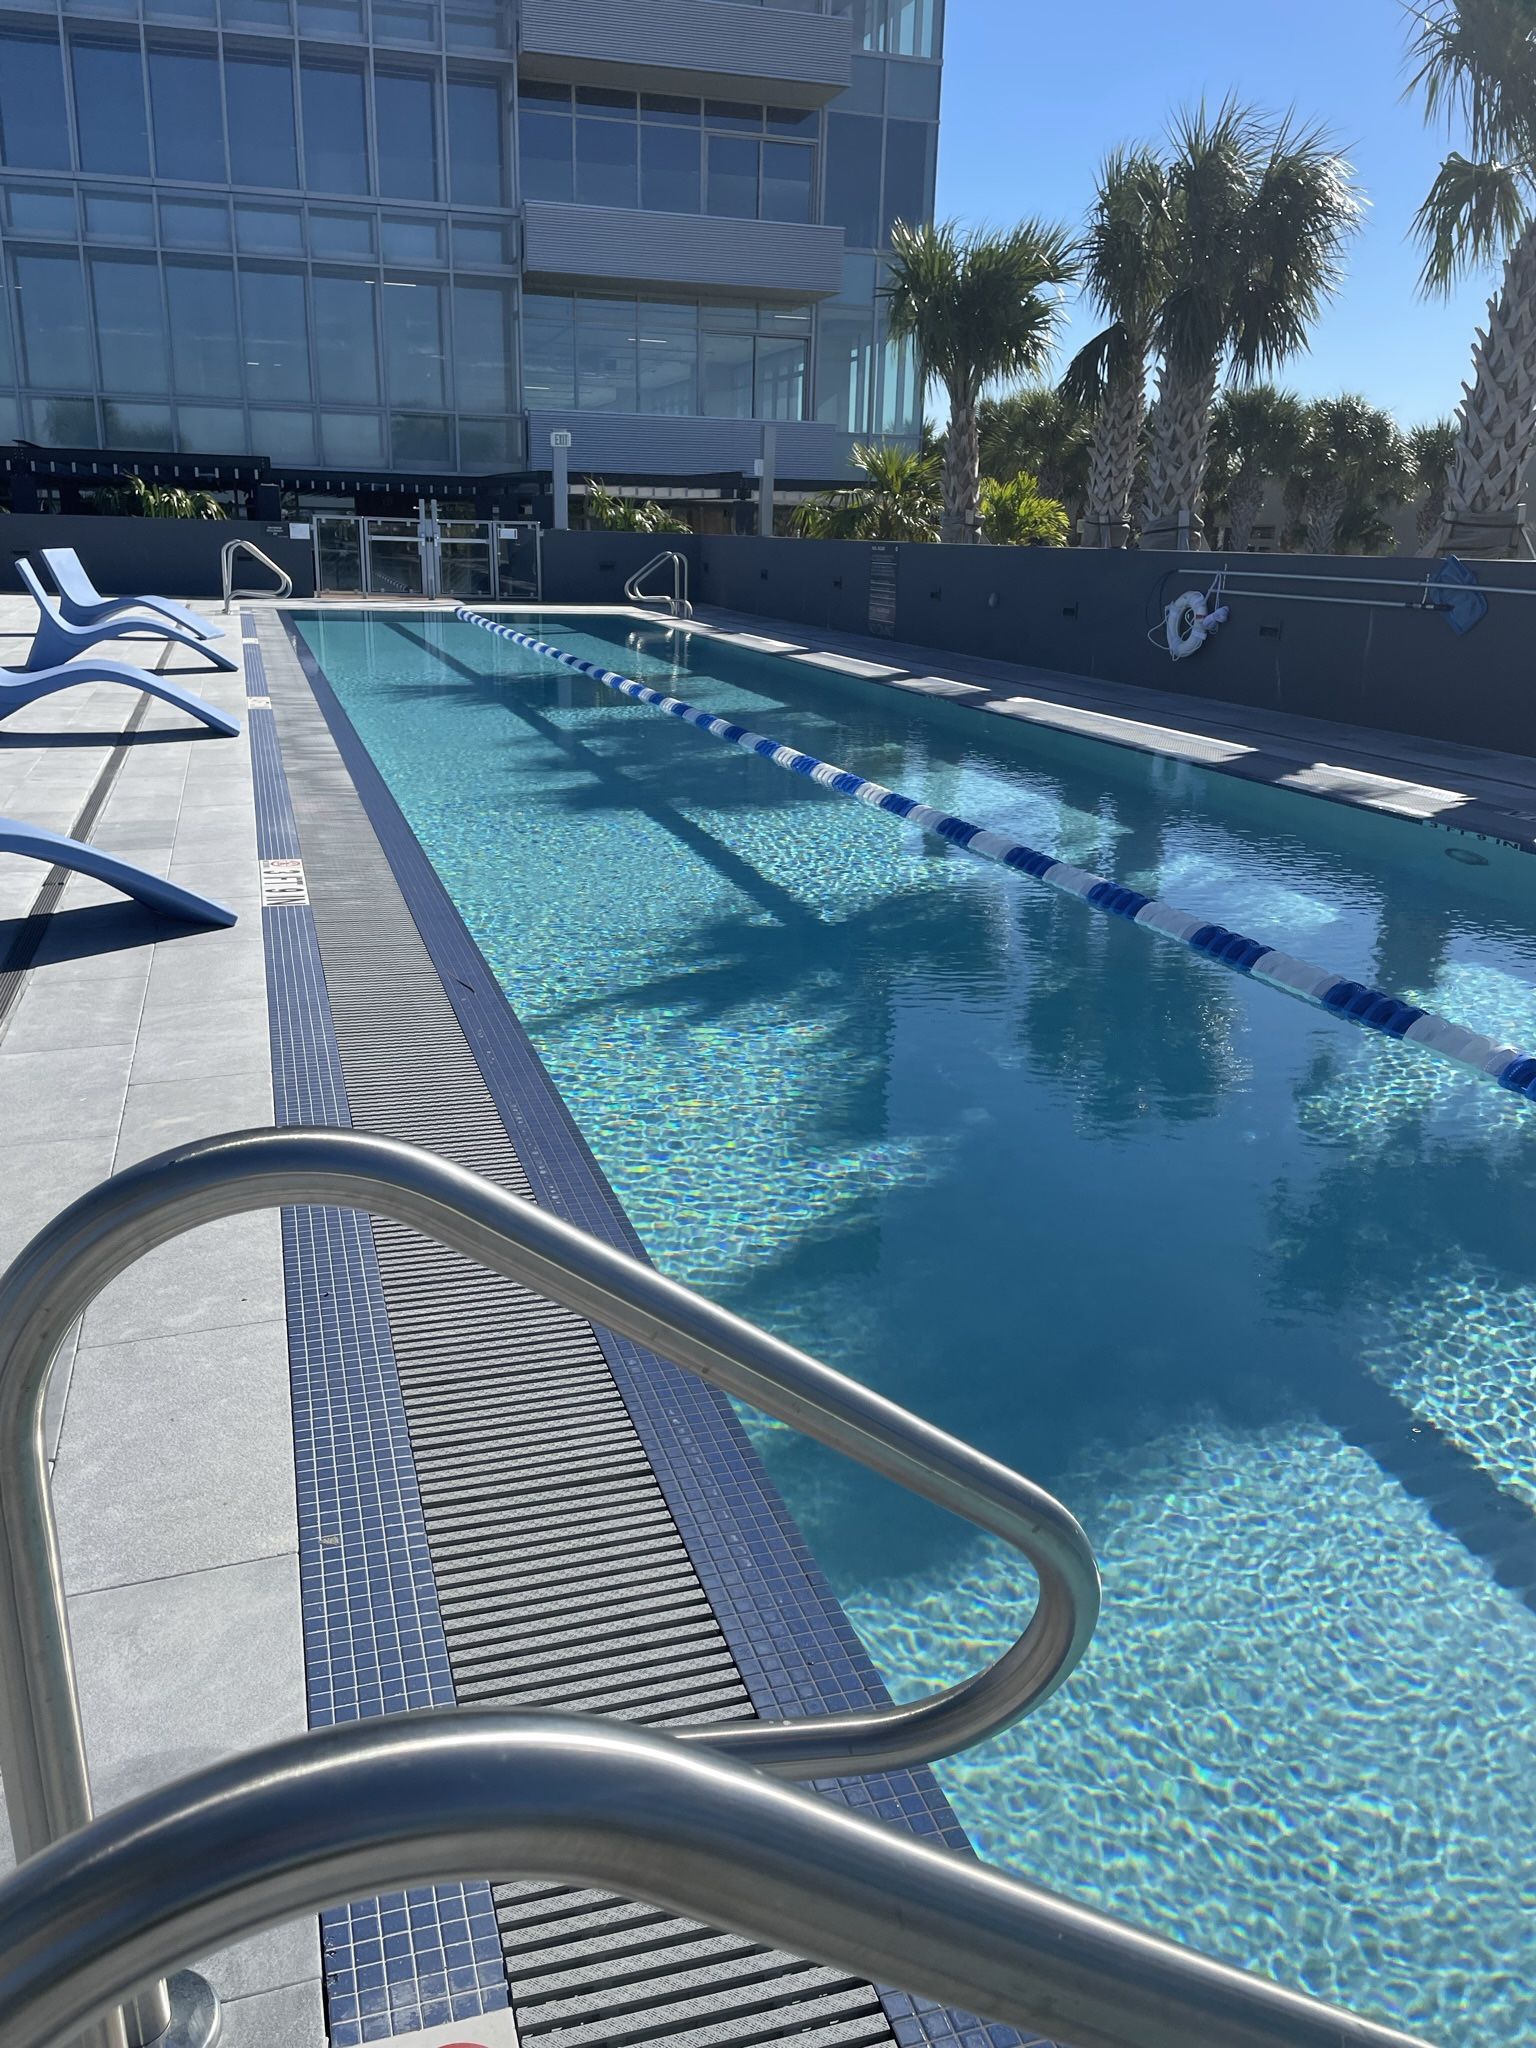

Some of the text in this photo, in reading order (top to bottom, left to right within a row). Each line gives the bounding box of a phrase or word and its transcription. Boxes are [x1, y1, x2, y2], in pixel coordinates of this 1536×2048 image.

[554, 434, 569, 446] EXIT
[263, 876, 304, 885] FT
[266, 895, 306, 906] IN
